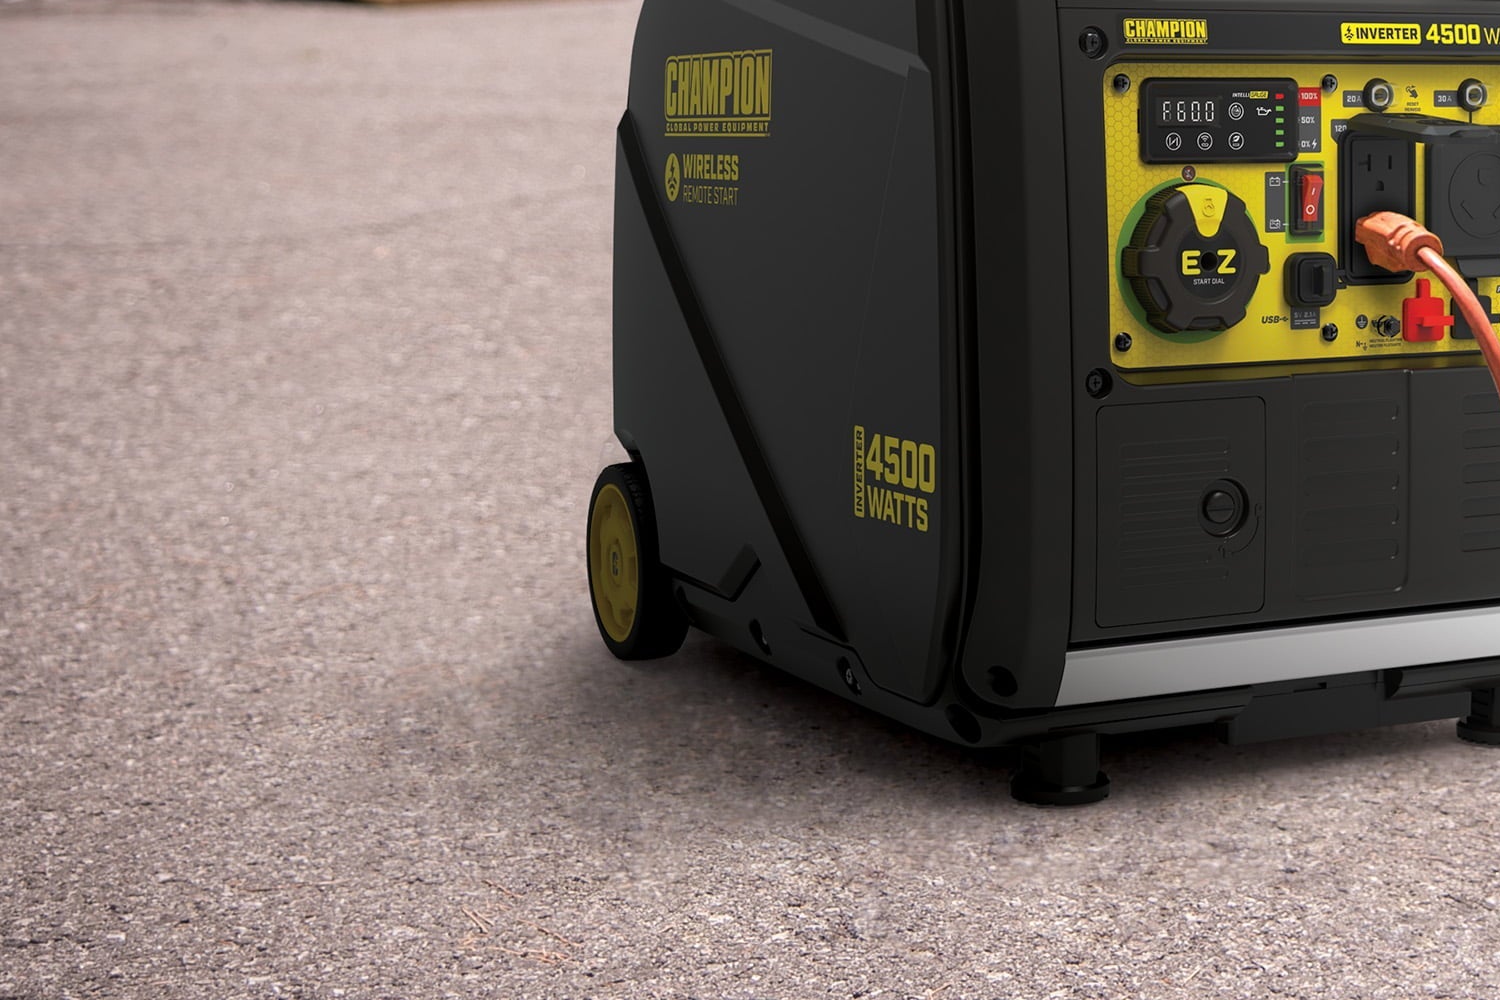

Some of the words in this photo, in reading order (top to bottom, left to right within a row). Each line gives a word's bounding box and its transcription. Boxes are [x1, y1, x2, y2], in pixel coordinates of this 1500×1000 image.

[1124, 18, 1208, 39] CHAMPION
[1356, 27, 1418, 40] INVERTER
[1425, 23, 1481, 45] 4500
[666, 55, 770, 117] CHAMPION
[1301, 92, 1318, 100] 100%
[666, 122, 691, 132] GLOBAL
[693, 122, 719, 132] POWER
[722, 122, 769, 132] EQUIPMENT
[1301, 116, 1315, 124] 50%
[1301, 140, 1310, 148] 0%
[682, 153, 739, 181] WIRELESS
[682, 184, 712, 204] REMOTE
[714, 186, 739, 206] START
[1212, 277, 1225, 285] DIAL
[1261, 315, 1280, 324] USB
[855, 429, 863, 513] INVERTER
[865, 433, 936, 494] 4500
[866, 484, 929, 532] WATTS
